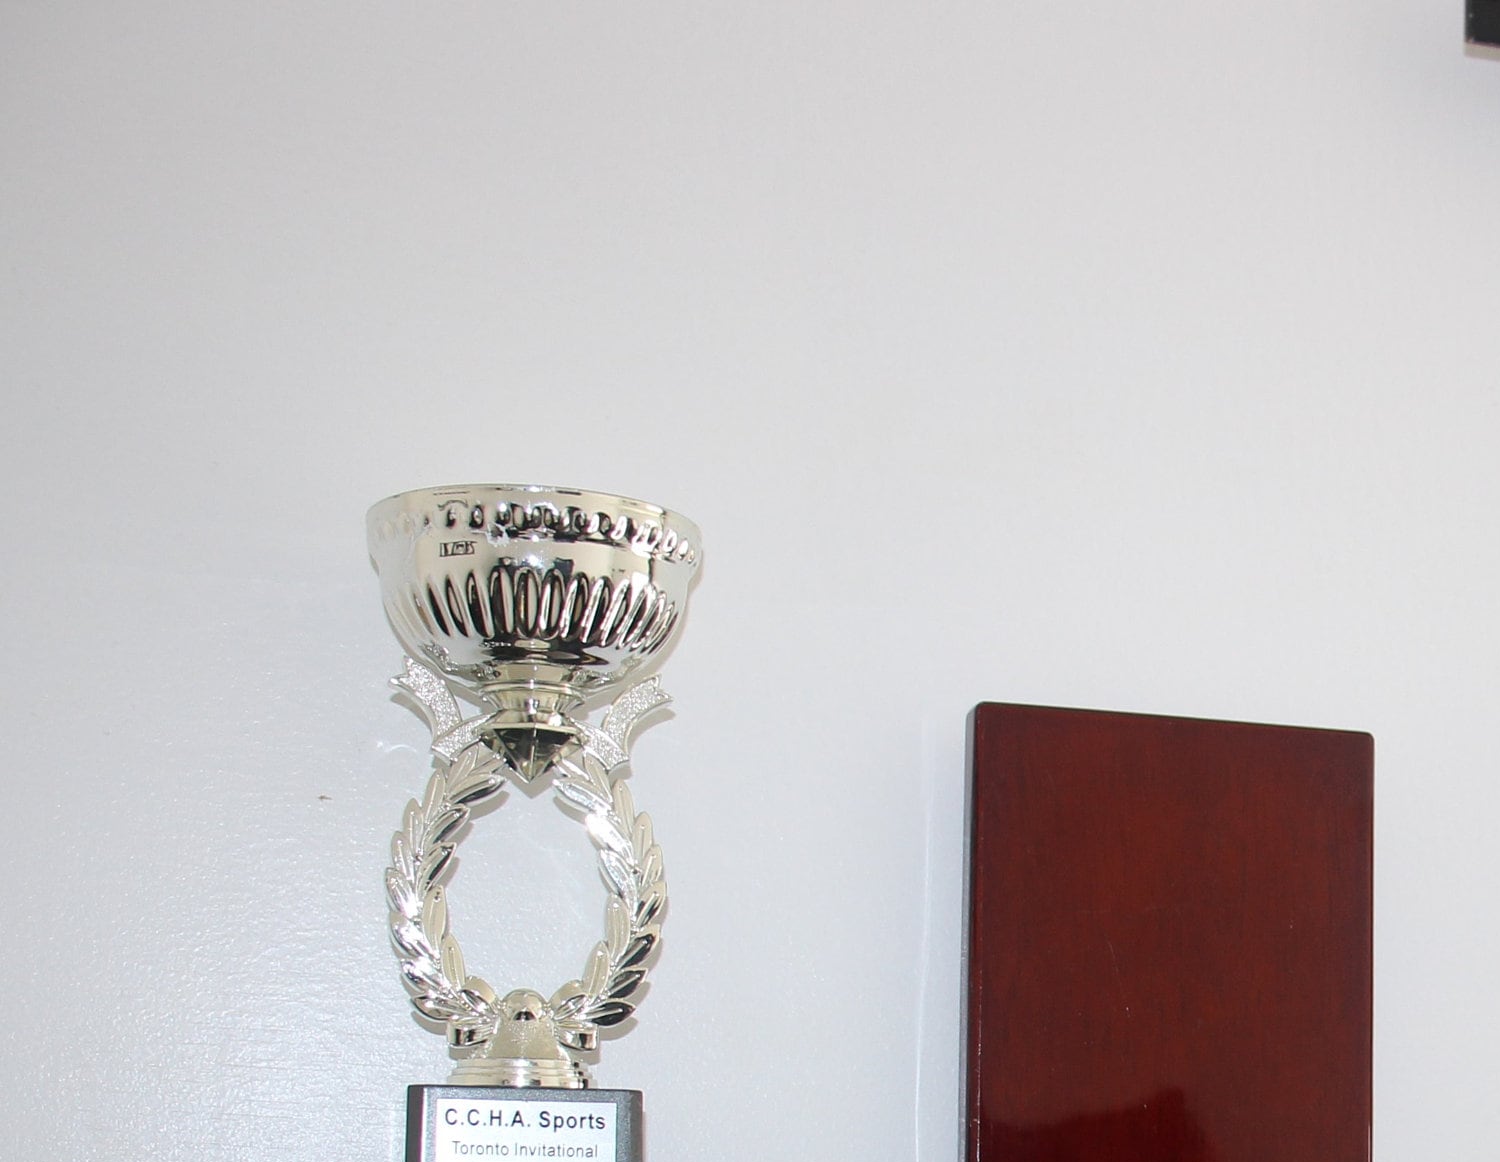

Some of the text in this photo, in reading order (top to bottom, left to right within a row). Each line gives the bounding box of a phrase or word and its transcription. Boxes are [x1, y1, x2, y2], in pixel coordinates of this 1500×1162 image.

[444, 1108, 606, 1132] C.C.H.A. Sports
[452, 1141, 598, 1158] Toronto Invitational
